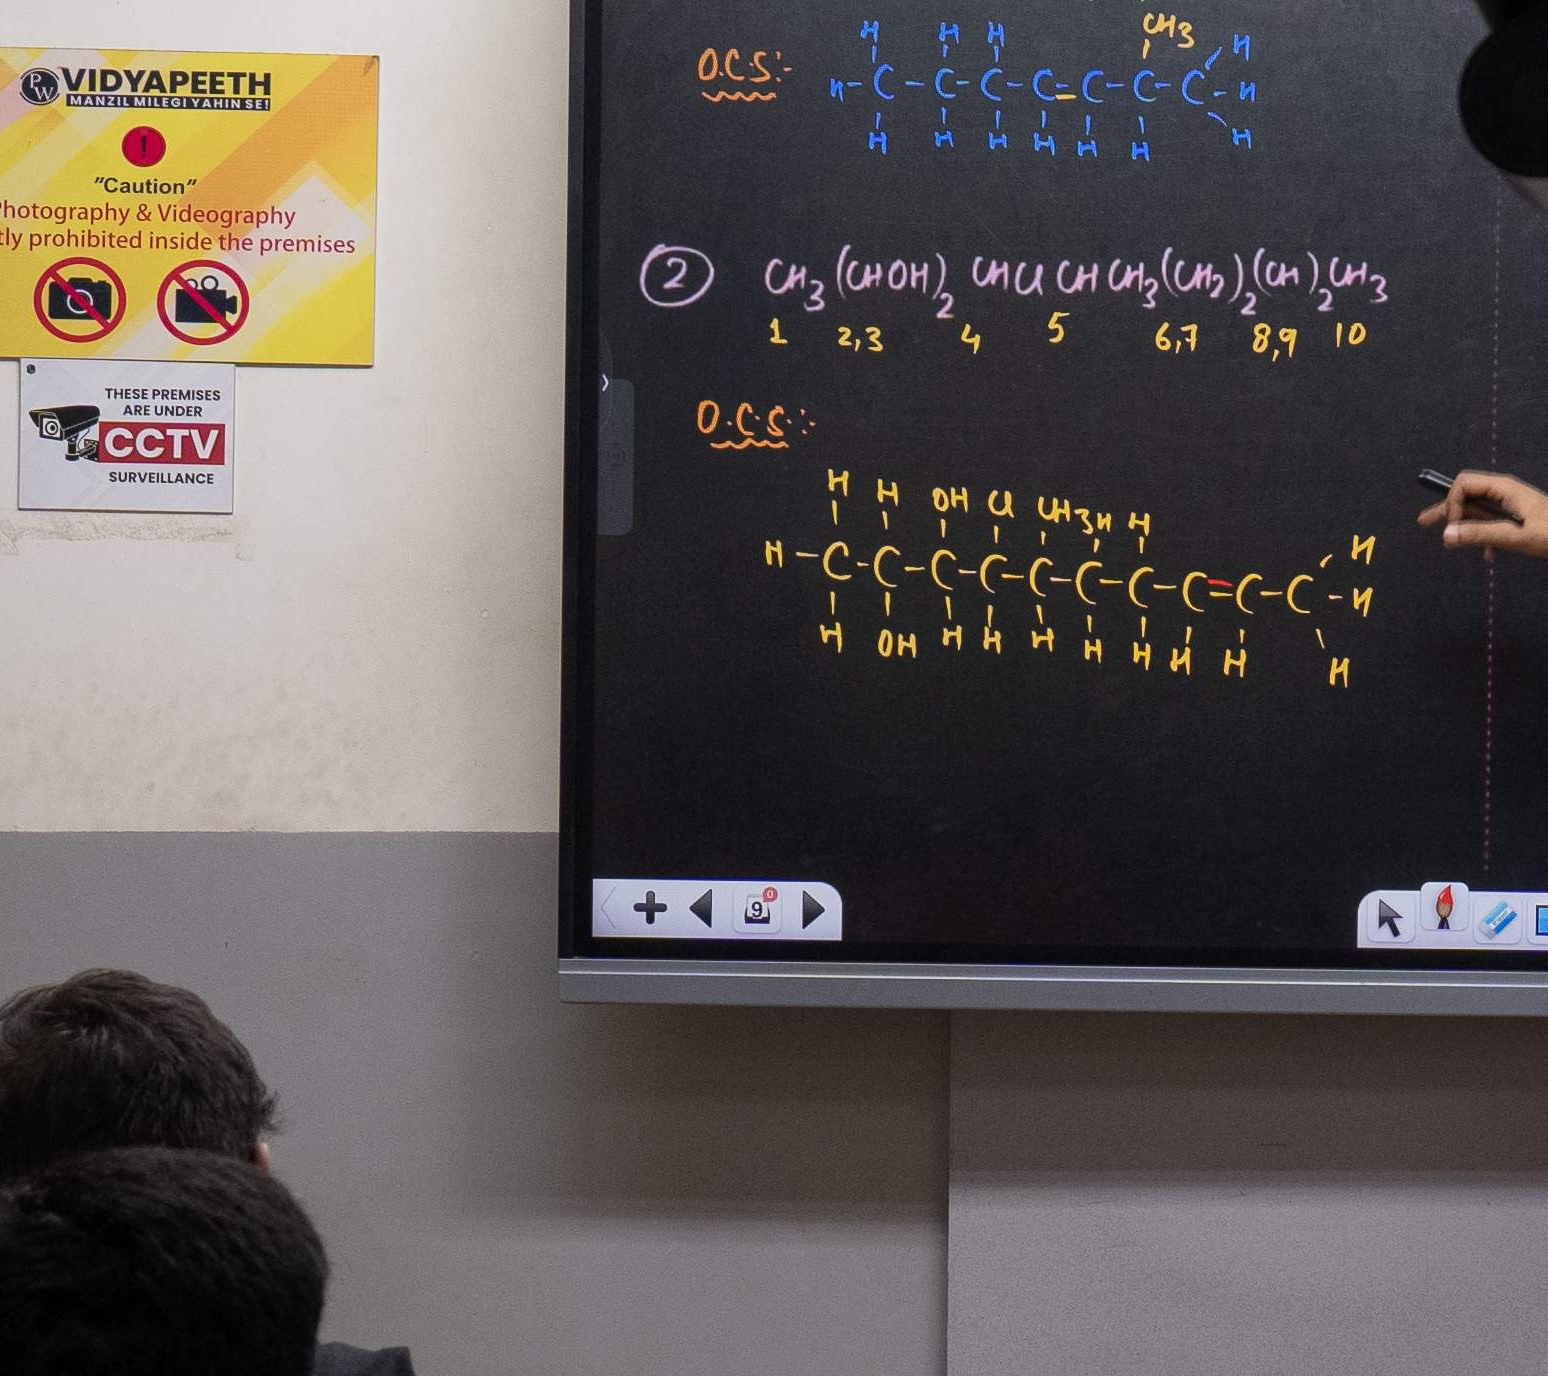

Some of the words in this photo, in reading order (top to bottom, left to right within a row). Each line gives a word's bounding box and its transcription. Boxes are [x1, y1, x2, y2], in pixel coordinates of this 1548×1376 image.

[63, 68, 271, 96] VIDYAPEETH
[70, 96, 130, 107] MANZIL
[134, 97, 188, 108] MILEGI
[191, 98, 241, 109] YAHIN
[245, 99, 270, 110] SE!
[136, 204, 152, 222] &
[157, 204, 296, 229] Videography
[29, 229, 142, 250] prohibited
[149, 232, 213, 251] inside
[218, 234, 253, 252] the
[259, 235, 356, 255] premises
[768, 319, 788, 345] 1
[960, 324, 982, 355] 4
[1047, 312, 1070, 343] 5
[1336, 321, 1367, 347] 10
[104, 387, 148, 400] THESE
[151, 388, 220, 401] PREMISES
[122, 404, 150, 416] ARE
[154, 405, 202, 417] UNDER
[104, 427, 219, 459] CCTV
[108, 471, 214, 484] SURVEILLANCE
[751, 901, 763, 918] 9
